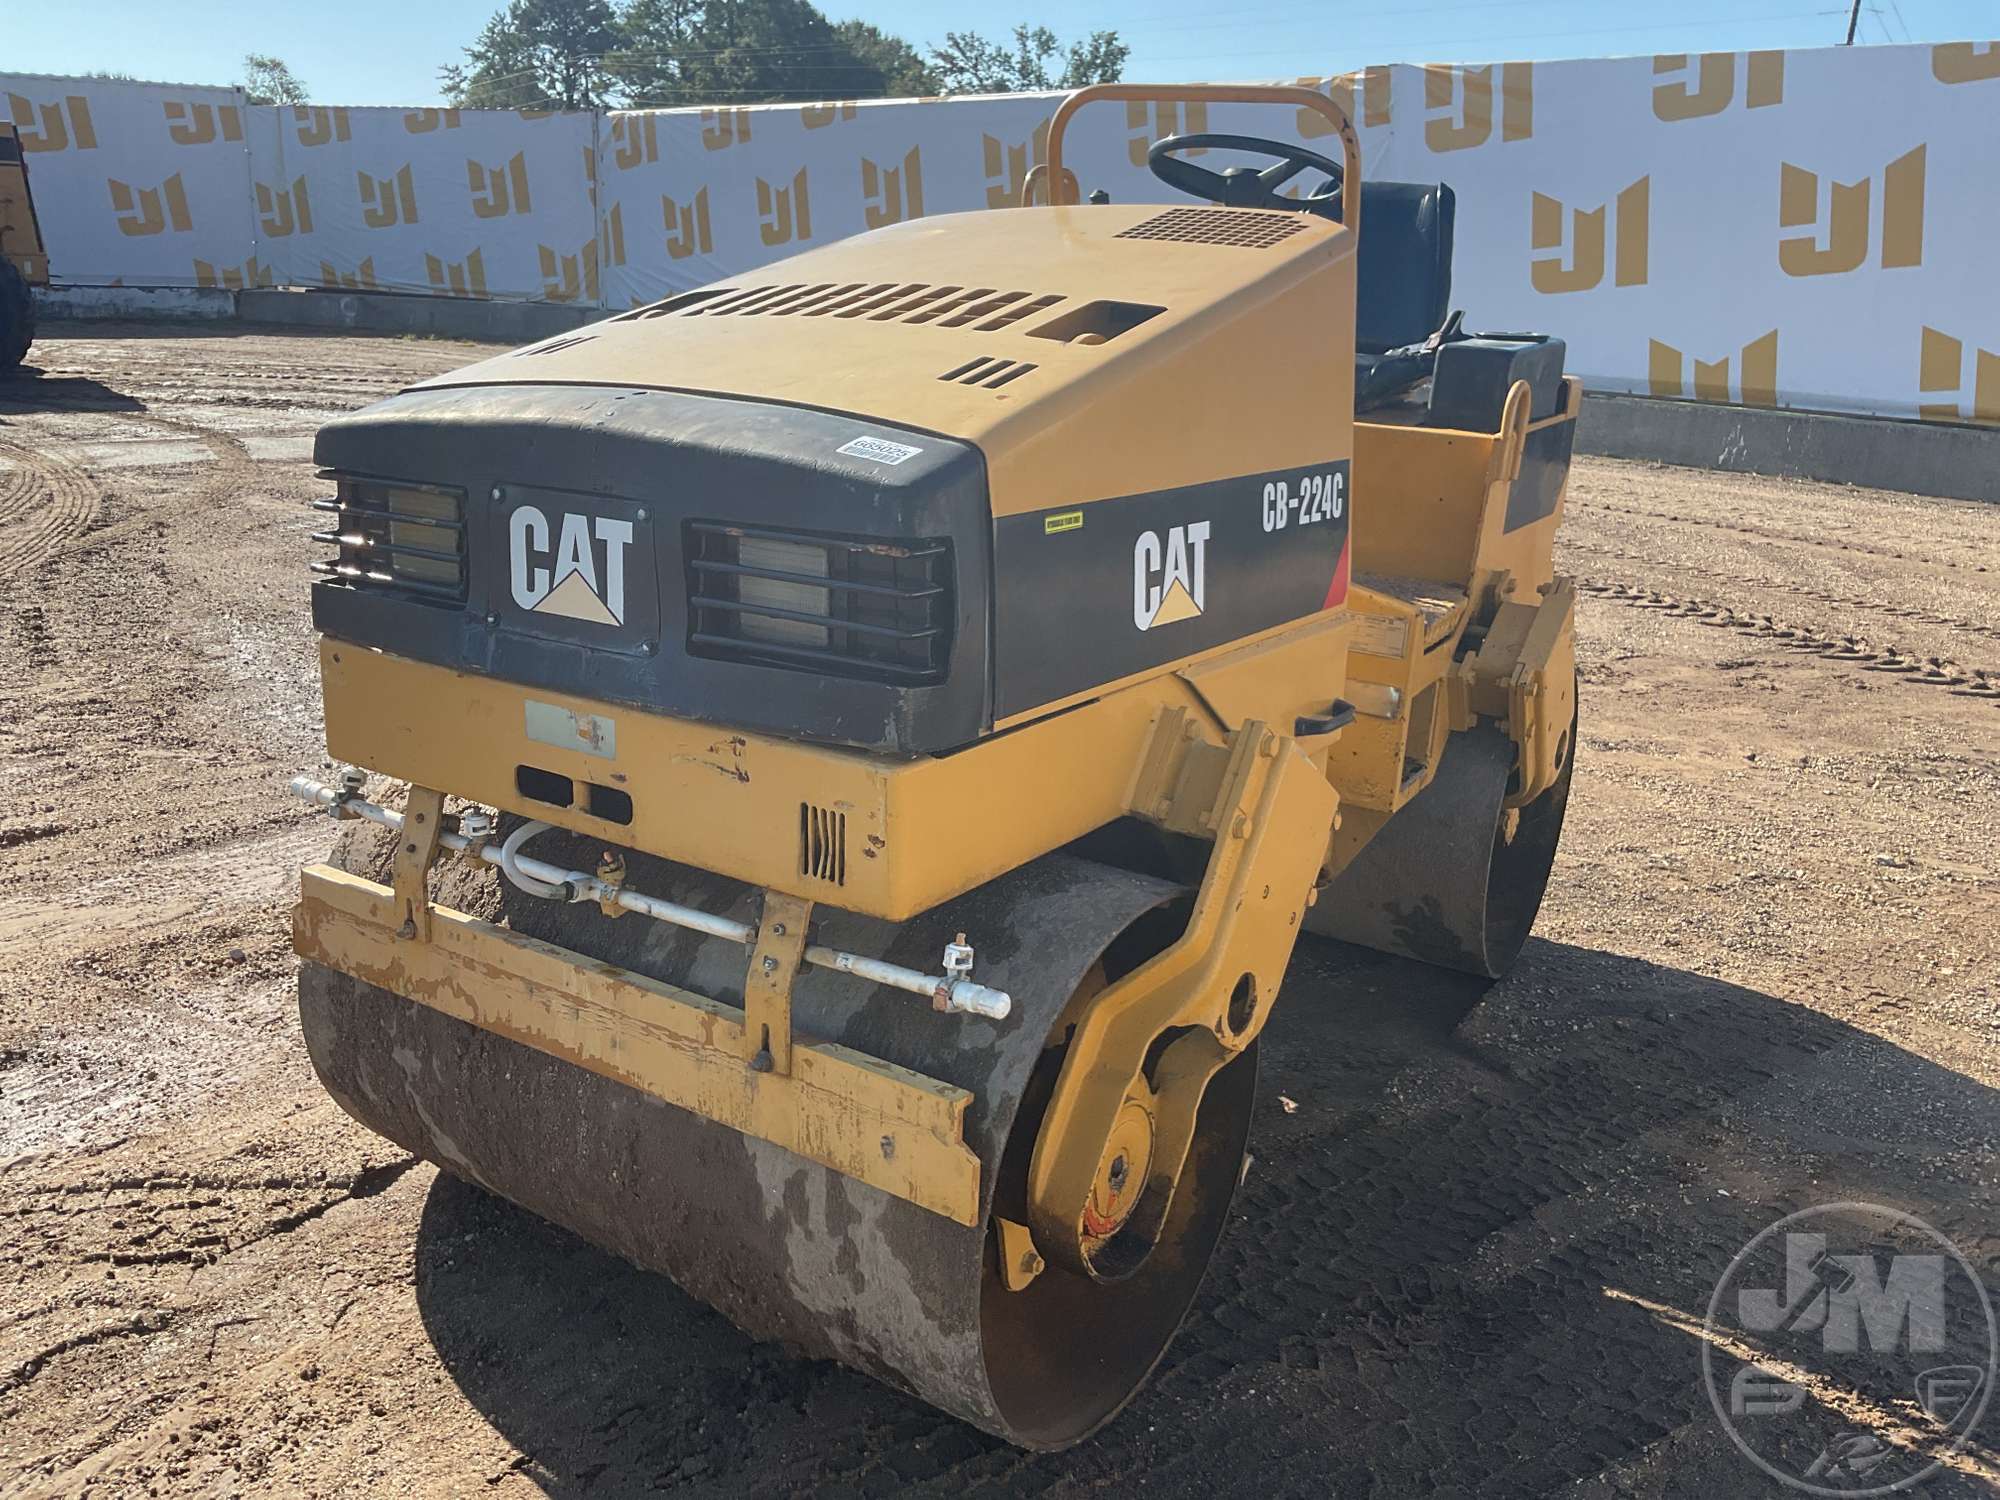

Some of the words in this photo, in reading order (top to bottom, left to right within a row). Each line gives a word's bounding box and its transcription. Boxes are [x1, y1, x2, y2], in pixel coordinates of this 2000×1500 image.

[1262, 472, 1344, 532] CB-224C
[509, 505, 633, 626] CAT
[1134, 520, 1210, 631] CAT
